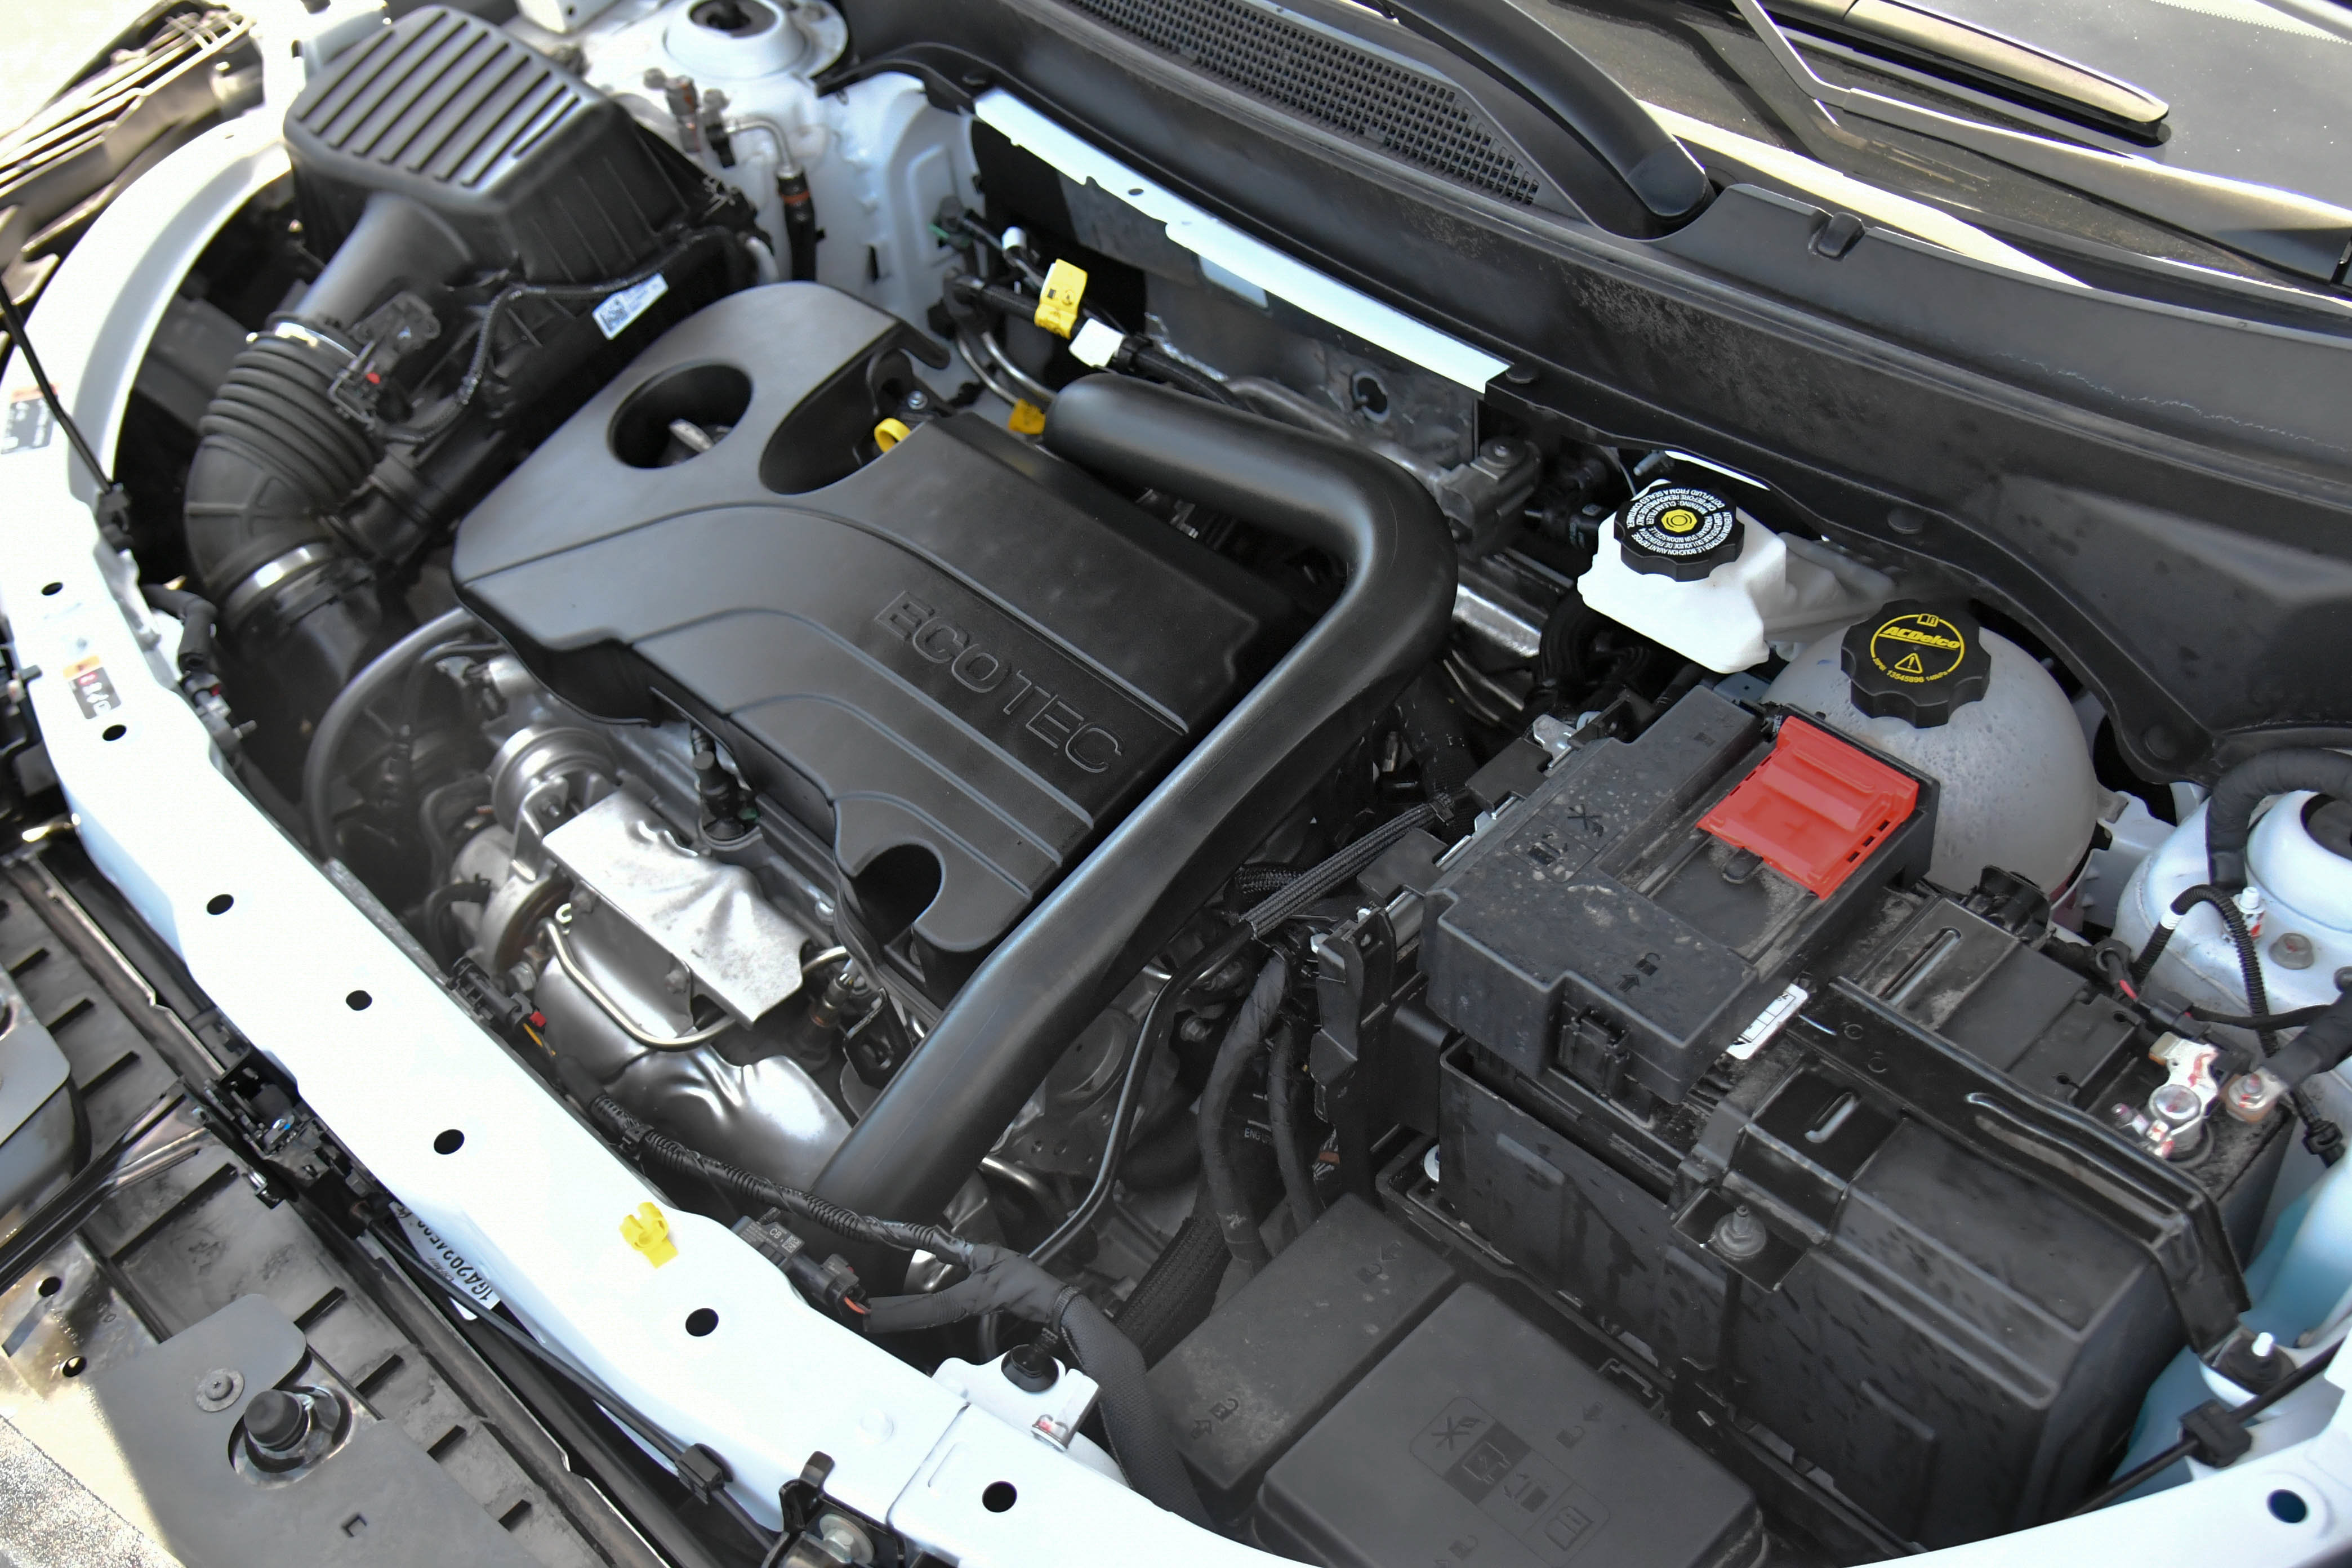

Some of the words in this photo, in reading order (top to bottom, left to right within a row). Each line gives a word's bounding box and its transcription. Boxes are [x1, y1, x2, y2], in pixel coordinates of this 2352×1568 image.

[1640, 492, 1664, 505] SEALED
[1680, 495, 1706, 505] BEFORE
[1654, 501, 1676, 512] CLEAN
[1703, 501, 1717, 511] CAP
[1646, 510, 1658, 525] FILLER
[1648, 545, 1668, 554] AVANT
[1882, 626, 1961, 648] ACDelco
[874, 590, 1124, 773] ECOTEC
